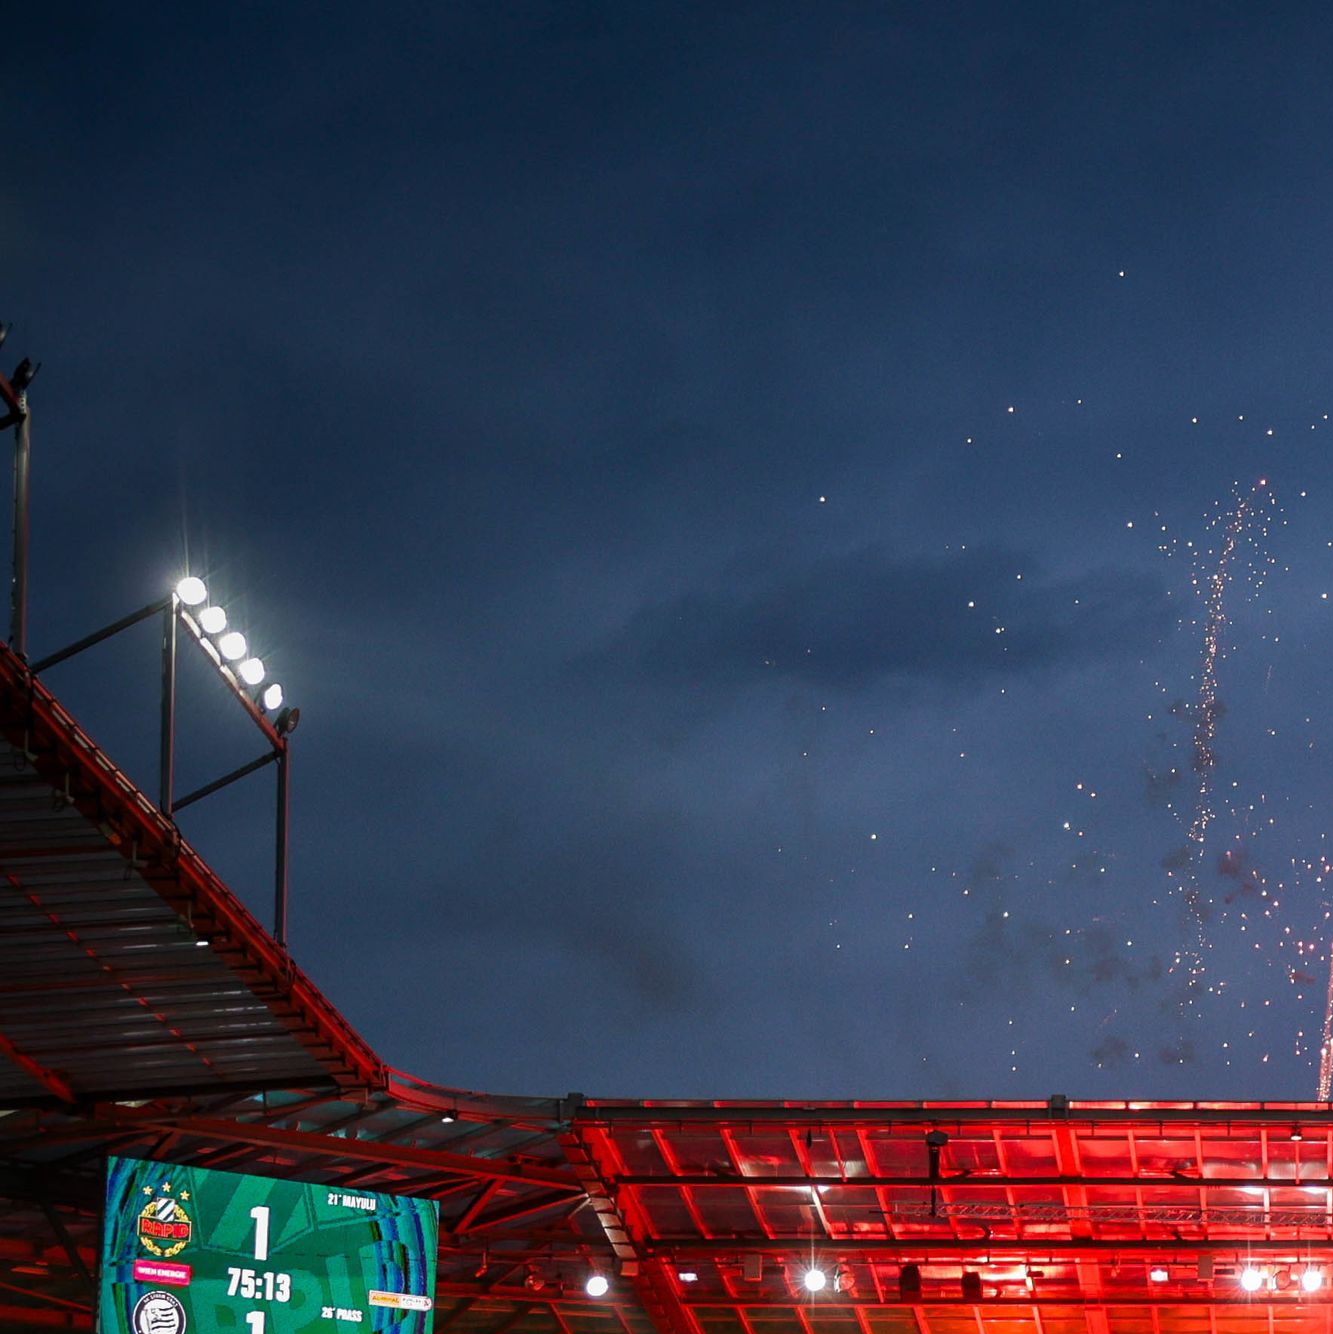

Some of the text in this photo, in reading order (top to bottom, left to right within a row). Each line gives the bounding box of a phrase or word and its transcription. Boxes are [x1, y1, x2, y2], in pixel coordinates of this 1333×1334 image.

[342, 1195, 377, 1211] MAYULU
[141, 1218, 190, 1239] RAPID
[250, 1206, 270, 1261] 1
[227, 1267, 292, 1302] 75:13
